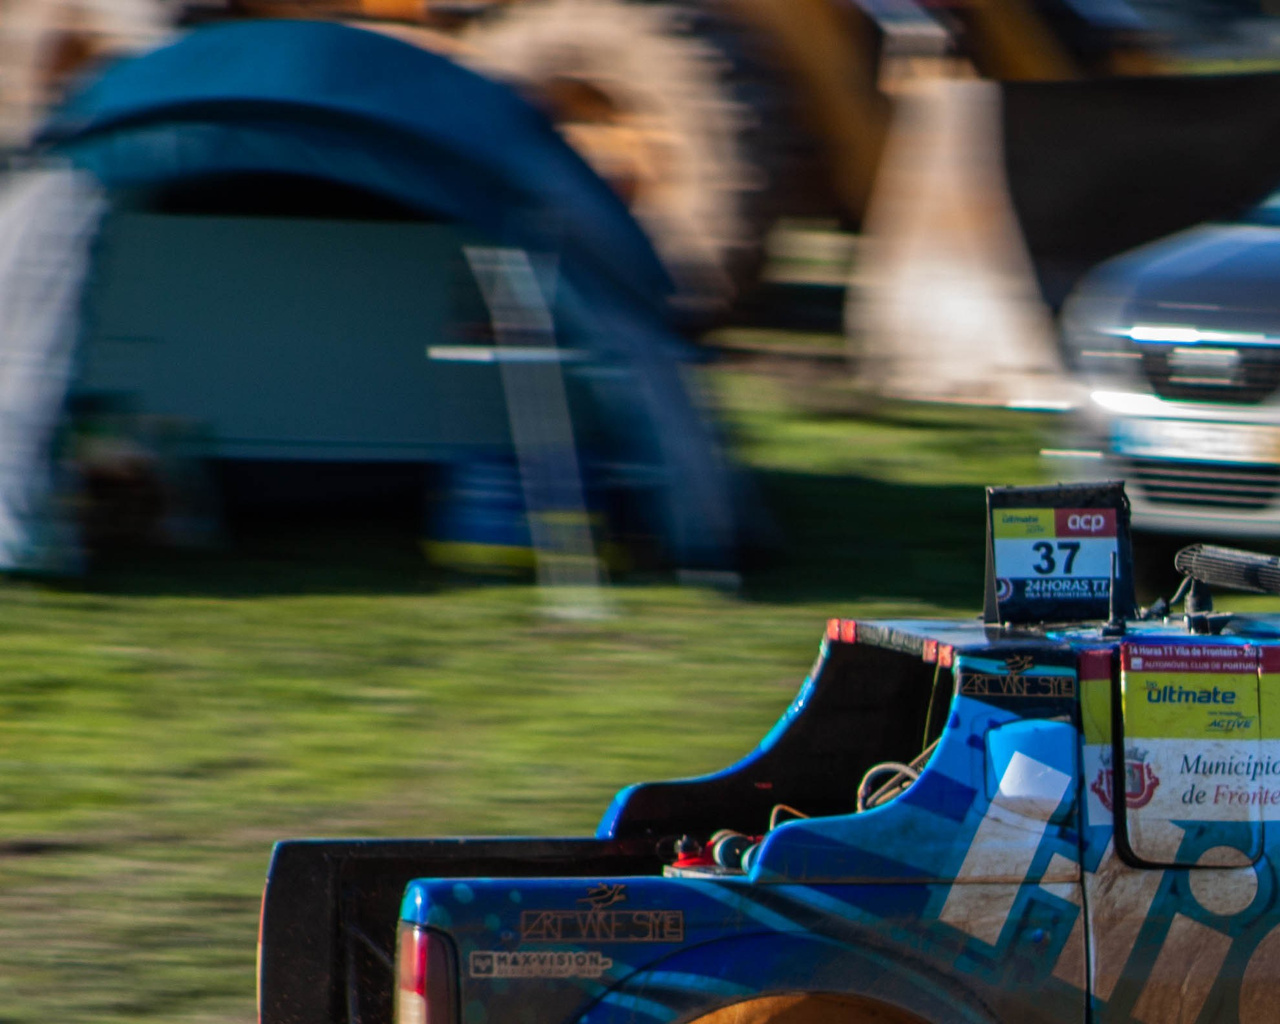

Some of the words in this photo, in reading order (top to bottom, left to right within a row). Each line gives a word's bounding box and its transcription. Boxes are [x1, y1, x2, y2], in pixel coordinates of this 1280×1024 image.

[1067, 514, 1105, 532] acp
[1032, 541, 1081, 574] 37
[1092, 580, 1108, 591] TT
[1140, 646, 1161, 656] Horas
[1164, 647, 1173, 656] TT
[1175, 647, 1190, 656] Vila
[1191, 647, 1201, 656] de
[1202, 647, 1238, 657] Fronteira
[1147, 686, 1236, 705] ultimate
[1210, 720, 1253, 730] ACTIVE
[1181, 784, 1207, 805] de
